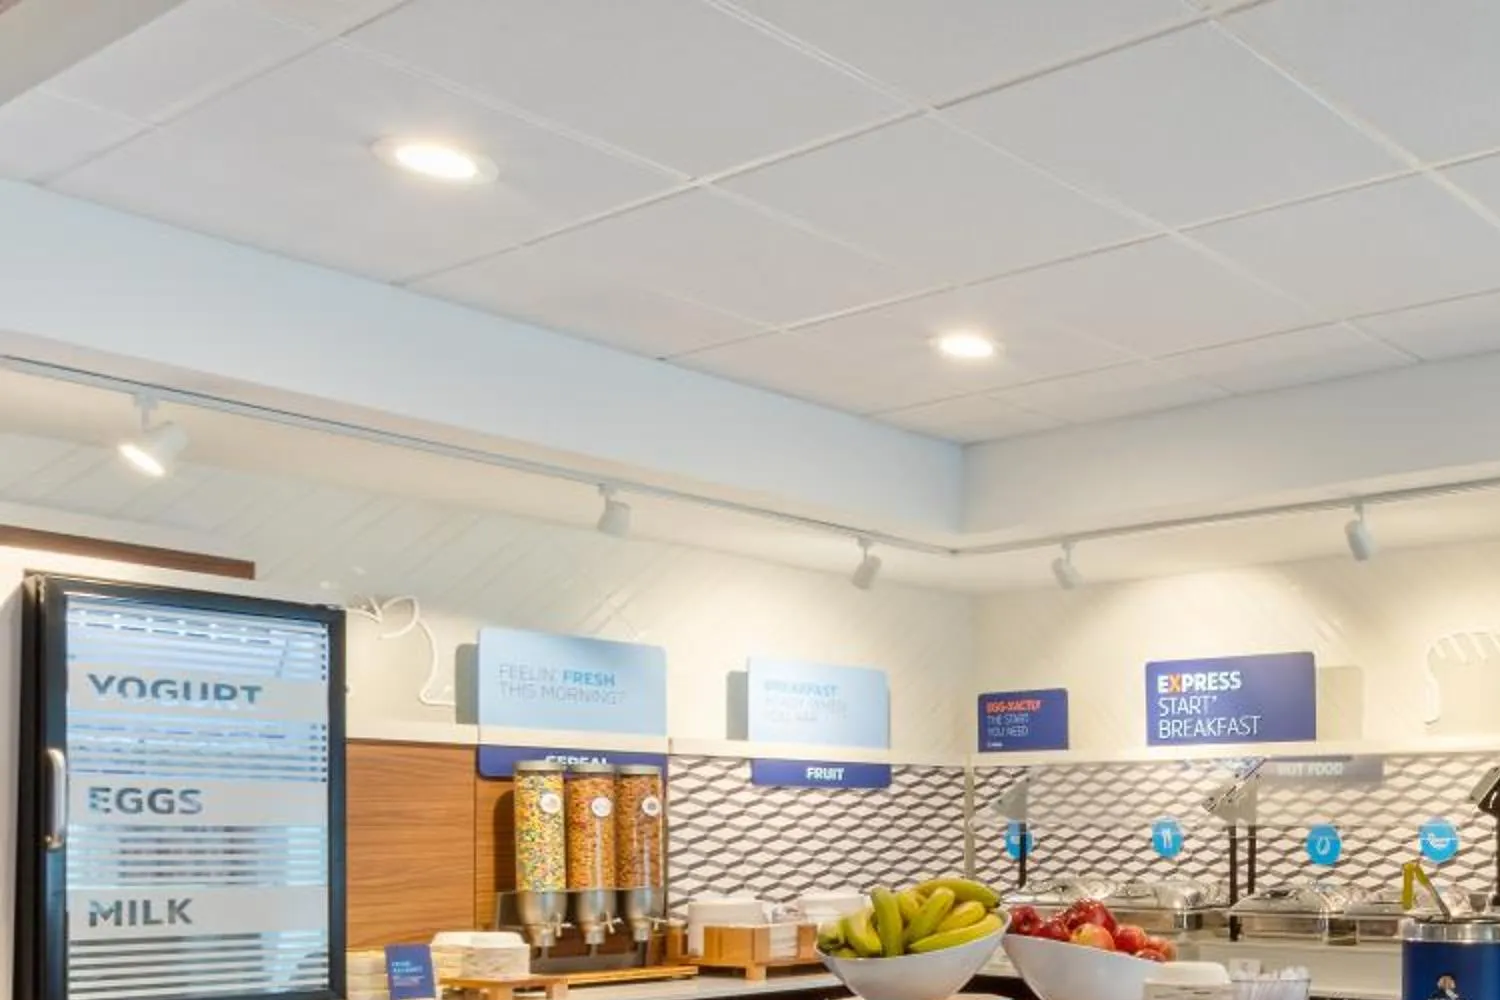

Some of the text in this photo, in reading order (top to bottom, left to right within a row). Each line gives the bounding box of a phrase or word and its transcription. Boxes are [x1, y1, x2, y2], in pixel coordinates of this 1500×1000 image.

[563, 670, 616, 687] FRESH
[1157, 671, 1242, 693] EXPRESS
[87, 674, 263, 707] YOGURT
[499, 682, 537, 699] THIS
[1158, 715, 1262, 740] BREAKFAST
[806, 767, 845, 781] FRUIT
[1307, 761, 1344, 776] FOOD
[88, 787, 203, 815] EGGS
[89, 898, 193, 927] MILK
